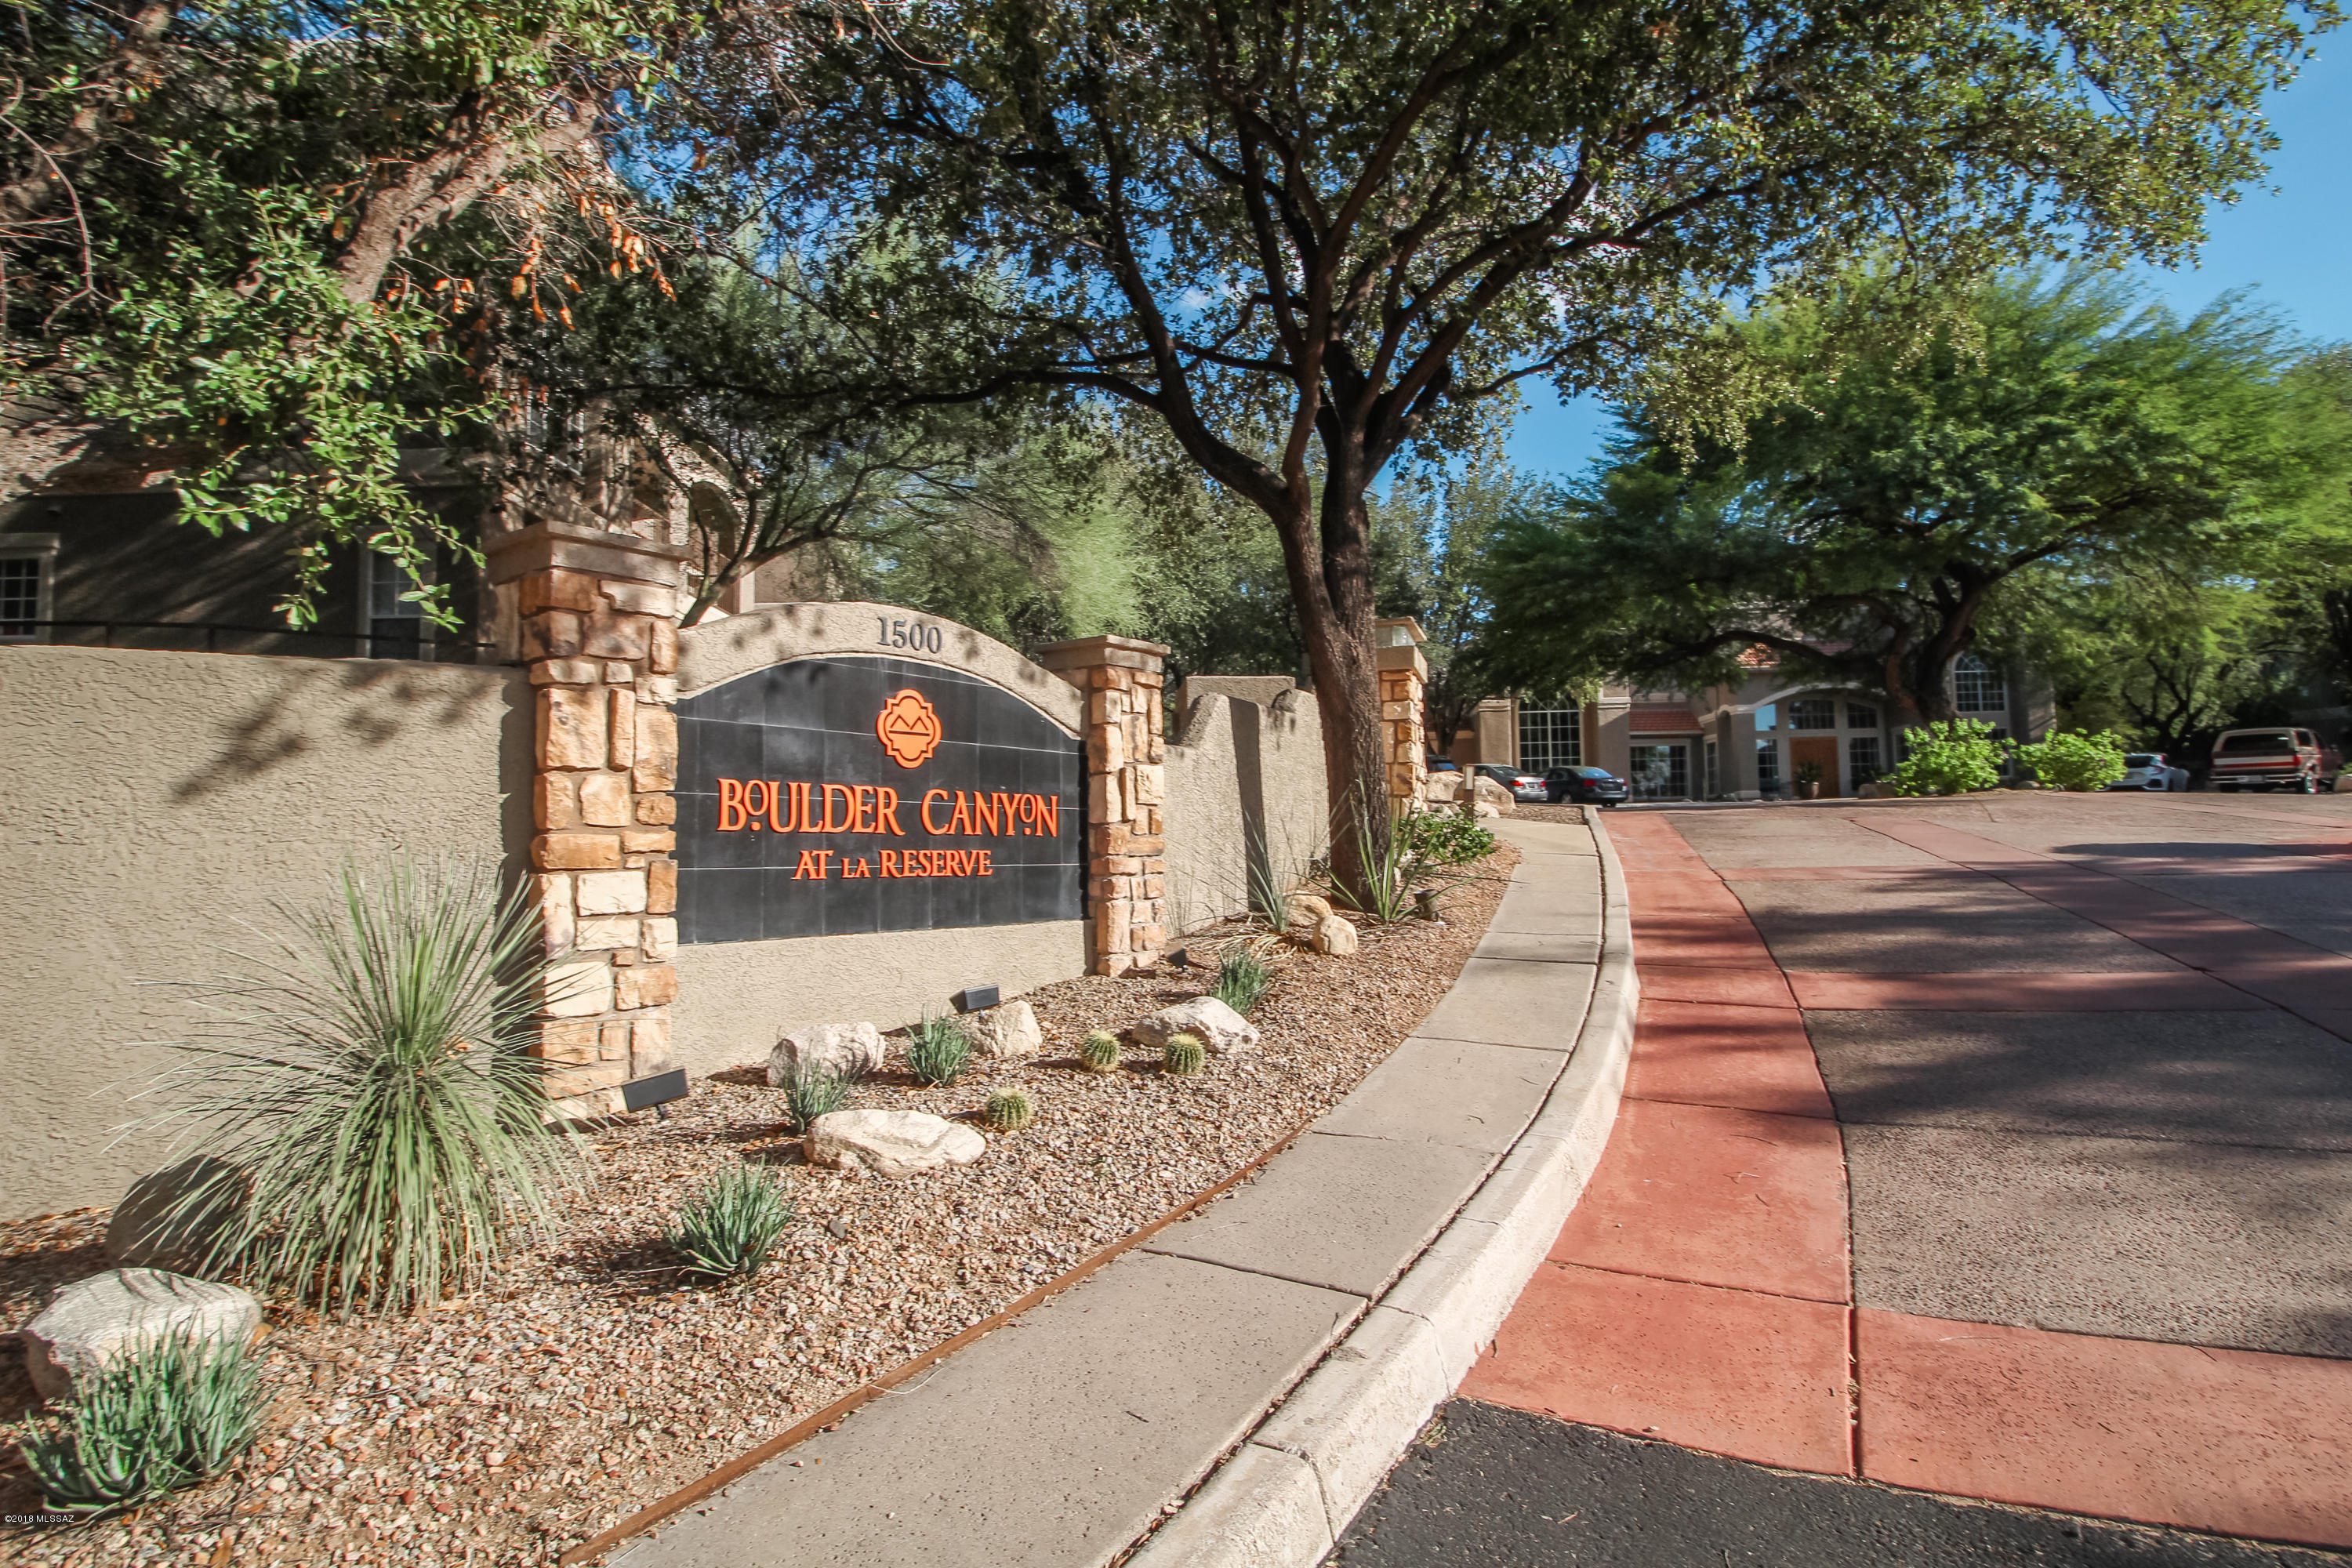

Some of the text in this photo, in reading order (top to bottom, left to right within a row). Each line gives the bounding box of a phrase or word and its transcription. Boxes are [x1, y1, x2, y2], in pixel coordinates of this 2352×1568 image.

[877, 616, 942, 653] 1500
[717, 778, 1059, 837] BOULDER CANYON
[791, 849, 993, 880] AT LA RESERVE
